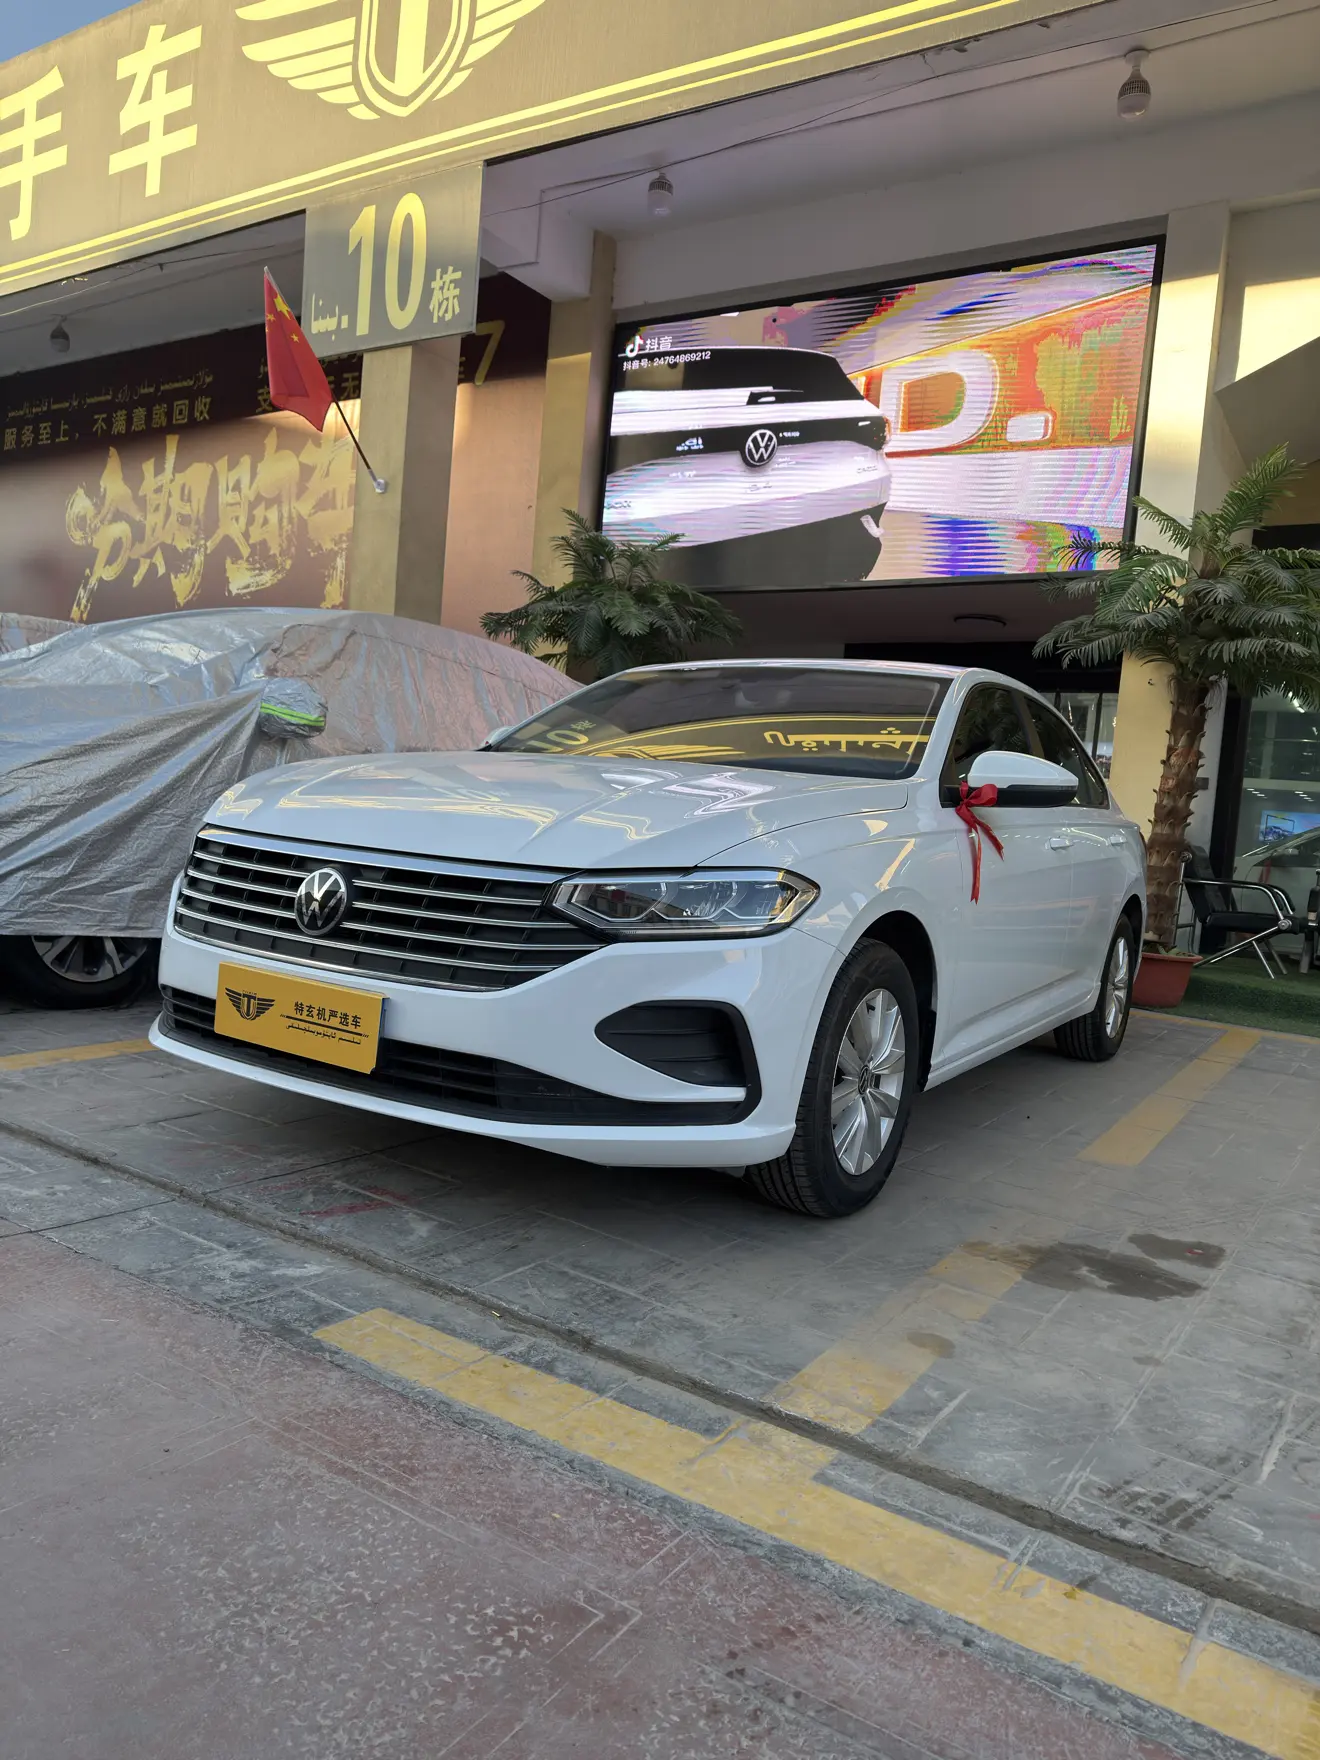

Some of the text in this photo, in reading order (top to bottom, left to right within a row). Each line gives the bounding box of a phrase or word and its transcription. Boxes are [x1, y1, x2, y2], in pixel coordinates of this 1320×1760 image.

[644, 336, 673, 352] 抖音
[293, 1001, 362, 1029] 特玄机严选车
